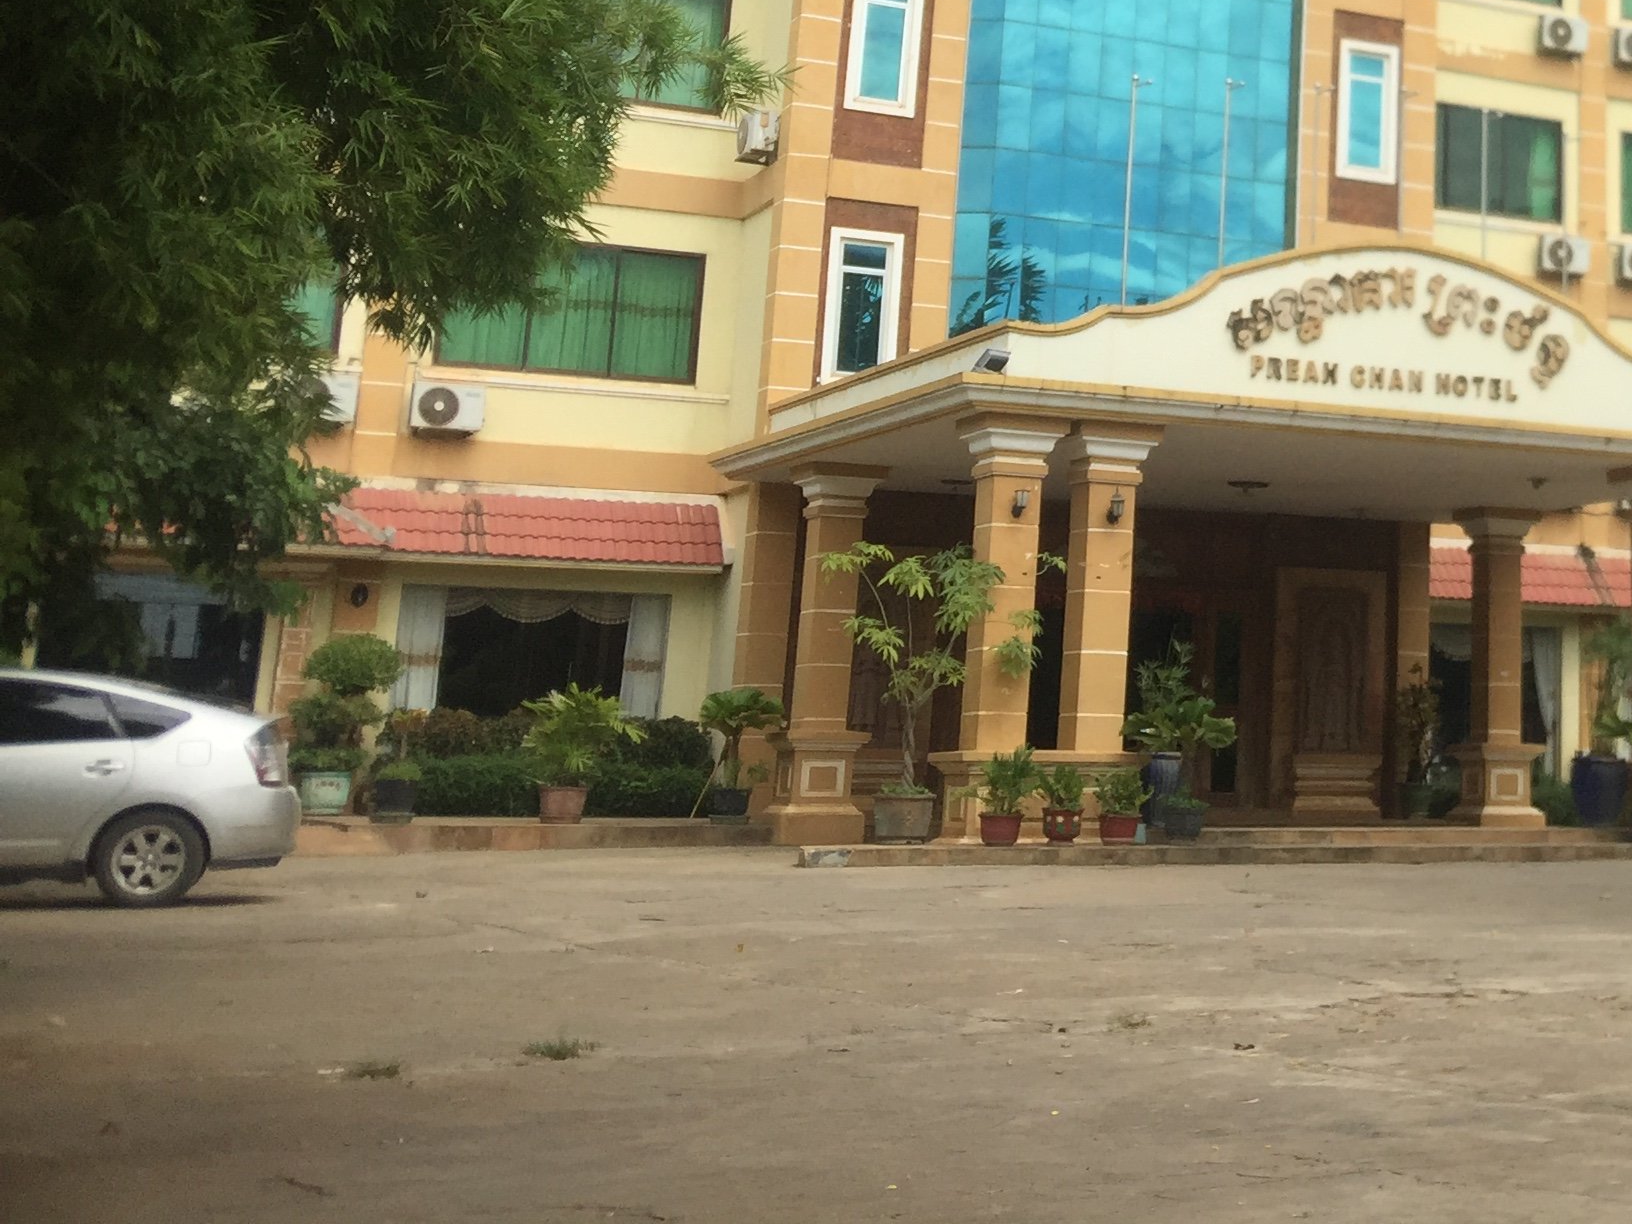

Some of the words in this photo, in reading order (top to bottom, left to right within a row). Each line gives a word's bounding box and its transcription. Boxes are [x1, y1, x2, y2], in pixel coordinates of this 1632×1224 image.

[1250, 354, 1339, 385] PREAH
[1350, 364, 1424, 393] CHAN
[1435, 373, 1518, 403] HOTEL
